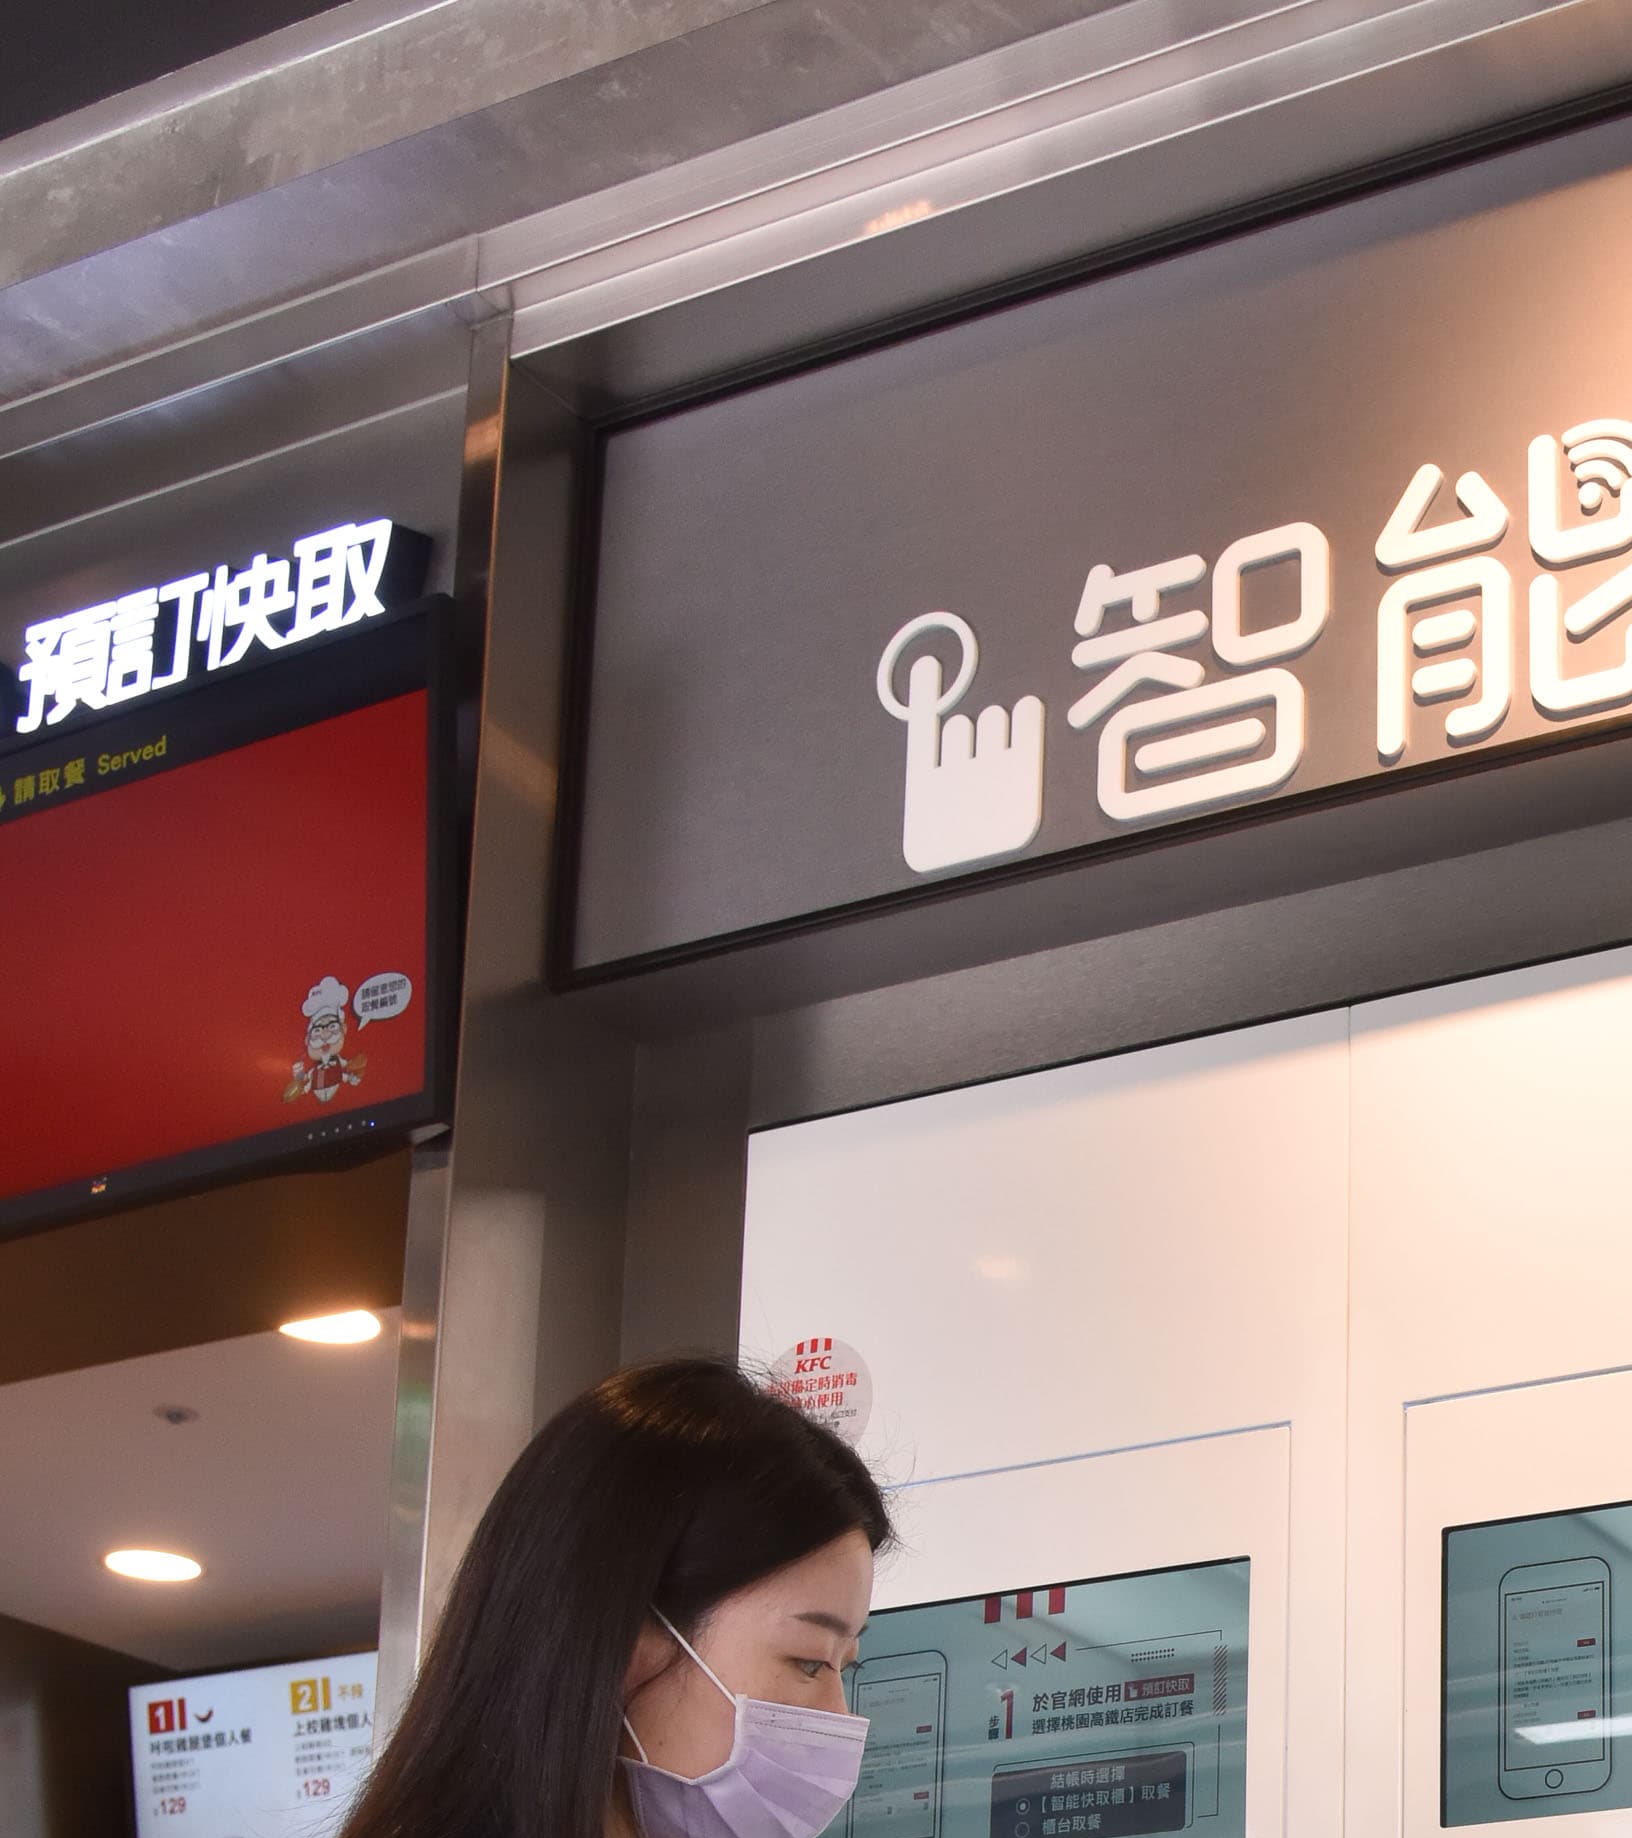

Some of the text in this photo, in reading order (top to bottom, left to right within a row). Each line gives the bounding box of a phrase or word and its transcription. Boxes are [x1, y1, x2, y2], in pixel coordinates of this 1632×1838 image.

[16, 517, 394, 733] 預訂快取
[13, 735, 168, 806] 請取餐 Served
[794, 1355, 832, 1374] KFC
[1032, 1678, 1190, 1713] 於官網使用 預訂快取
